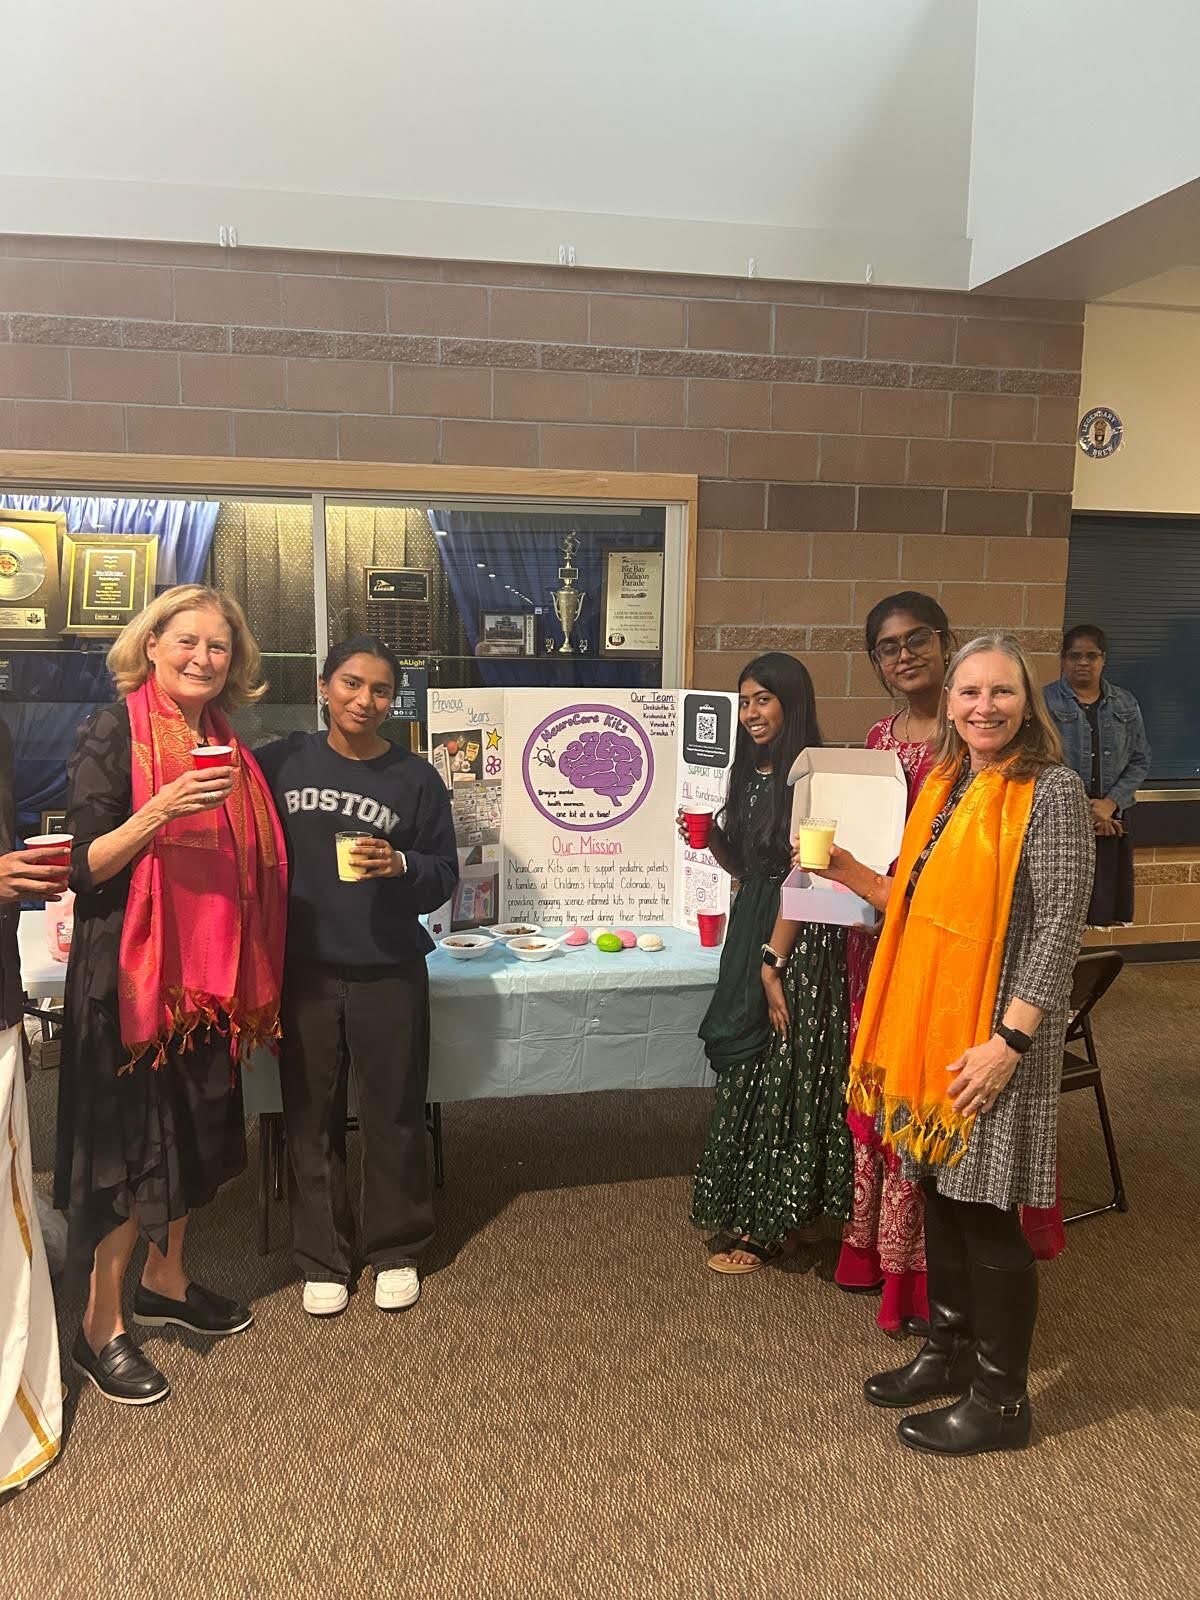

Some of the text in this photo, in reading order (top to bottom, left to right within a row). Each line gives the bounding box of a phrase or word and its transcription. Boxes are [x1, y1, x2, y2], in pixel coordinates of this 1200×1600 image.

[1082, 410, 1116, 432] LEGENDARY
[1093, 445, 1113, 457] BREW
[621, 565, 645, 574] Big Bay
[622, 579, 645, 587] Parade
[399, 659, 425, 667] eALight
[432, 691, 463, 711] Previous
[631, 691, 674, 703] Our Team
[467, 707, 490, 723] Years
[541, 713, 629, 742] NeuroCare Kits
[687, 764, 711, 777] SUPPORT
[696, 785, 727, 805] fundraisin
[284, 787, 400, 834] BOSTON
[569, 810, 577, 818] kit
[552, 835, 623, 855] Our Mission
[684, 849, 698, 862] OUR
[508, 859, 543, 873] NeuroCare
[547, 858, 564, 873] Kits
[566, 865, 580, 873] aim
[583, 859, 591, 873] to
[595, 859, 615, 876] support
[619, 860, 644, 876] pediatric
[540, 878, 548, 890] at
[553, 877, 586, 890] Children's
[588, 877, 615, 892] Hospital
[657, 877, 666, 892] by
[507, 894, 535, 911] providing
[537, 898, 561, 910] engaging
[612, 893, 624, 906] kits
[628, 894, 635, 905] to
[638, 893, 659, 908] promote
[660, 893, 671, 906] the
[533, 910, 540, 922] &
[542, 910, 564, 926] learning
[566, 910, 578, 926] they
[580, 909, 594, 921] need
[597, 910, 615, 926] during
[619, 910, 635, 921] their
